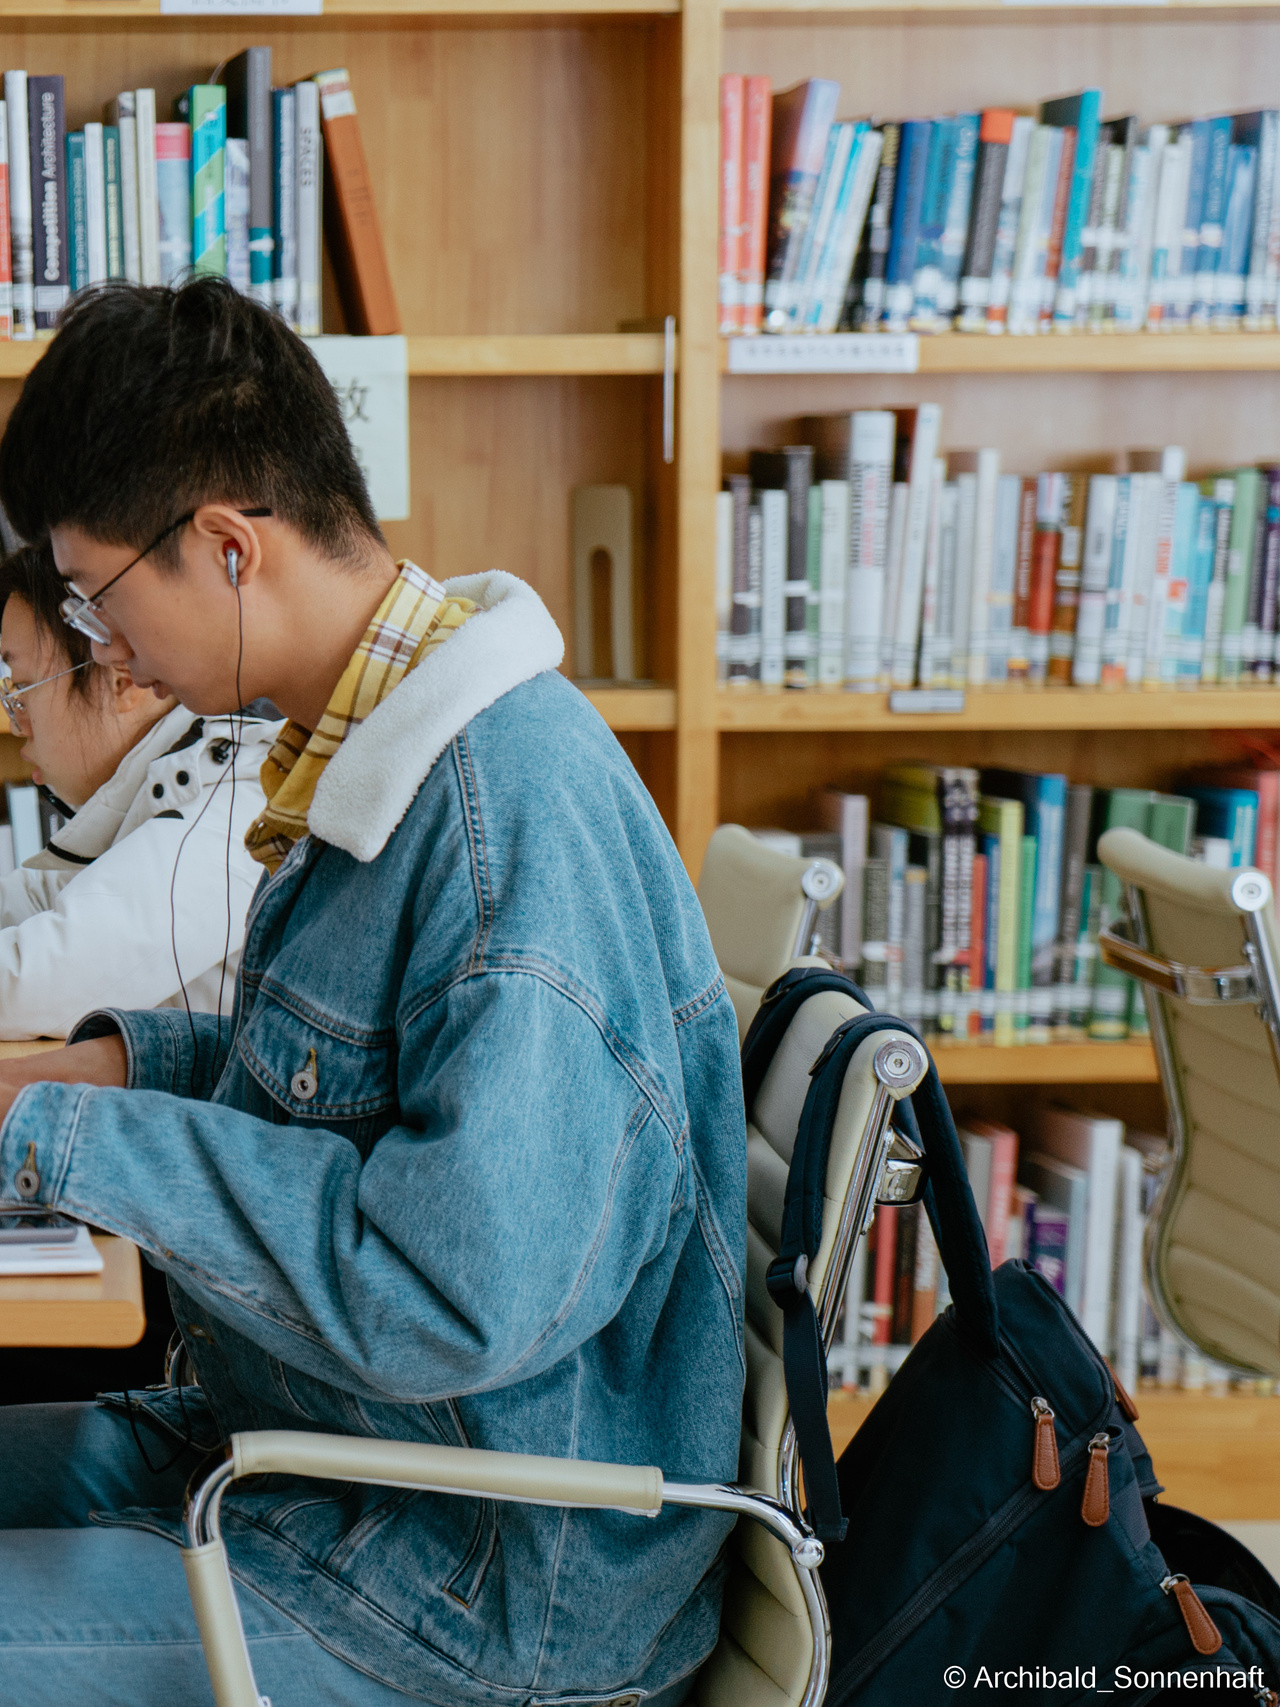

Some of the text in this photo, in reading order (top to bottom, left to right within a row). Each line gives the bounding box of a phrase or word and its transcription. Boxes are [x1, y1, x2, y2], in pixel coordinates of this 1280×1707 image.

[40, 91, 60, 281] Competition Architecture
[300, 126, 313, 187] SPACES
